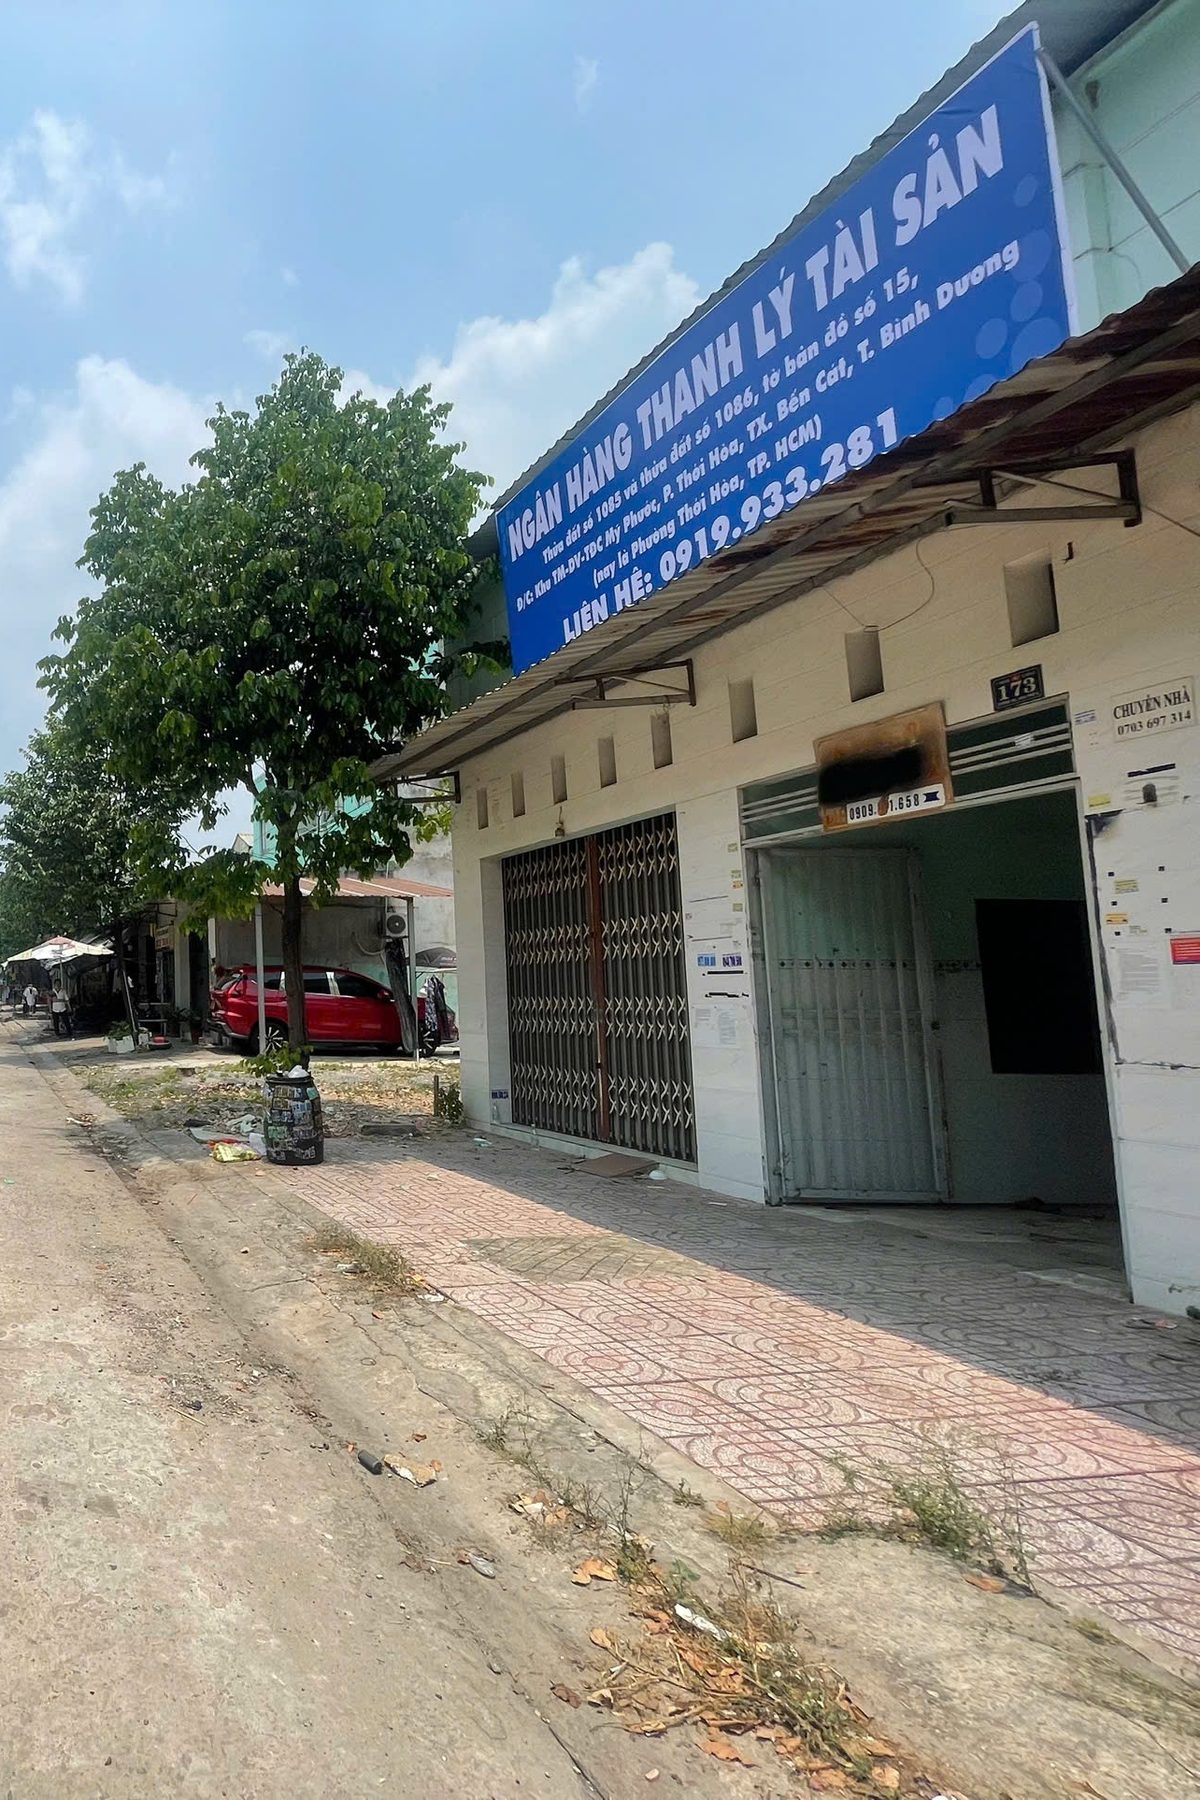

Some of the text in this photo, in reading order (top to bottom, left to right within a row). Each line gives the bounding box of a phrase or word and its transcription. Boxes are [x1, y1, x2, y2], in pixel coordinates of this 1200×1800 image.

[508, 103, 1003, 563] NGÂN HÀNG THANH LÝ TÀI SẢN
[534, 579, 551, 599] Khu
[662, 483, 675, 503] P.
[708, 438, 744, 470] Hòa,
[747, 412, 773, 442] TX.
[777, 388, 811, 421] Bến
[815, 357, 853, 392] Cát,
[857, 338, 874, 363] T.
[880, 300, 930, 349] Bình
[936, 239, 1020, 310] Dương
[583, 511, 594, 534] số
[596, 491, 621, 522] 1085
[623, 478, 638, 500] và
[670, 433, 692, 464] đất
[695, 417, 711, 445] số
[715, 385, 759, 428] 1086,
[784, 341, 819, 377] bản
[824, 313, 849, 347] đồ
[854, 289, 877, 326] số
[883, 266, 918, 302] 15,
[563, 594, 609, 643] LIÊN
[659, 406, 897, 582] 0919.933.281
[593, 560, 616, 589] (nay
[618, 549, 629, 569] là
[631, 519, 676, 559] Phường
[709, 474, 744, 505] Hòa,
[747, 451, 771, 479] TP.
[774, 413, 822, 461] HCM)
[997, 677, 1036, 701] 173
[1117, 710, 1191, 735] 0703 697 314
[849, 793, 920, 820] 0909.1.658
